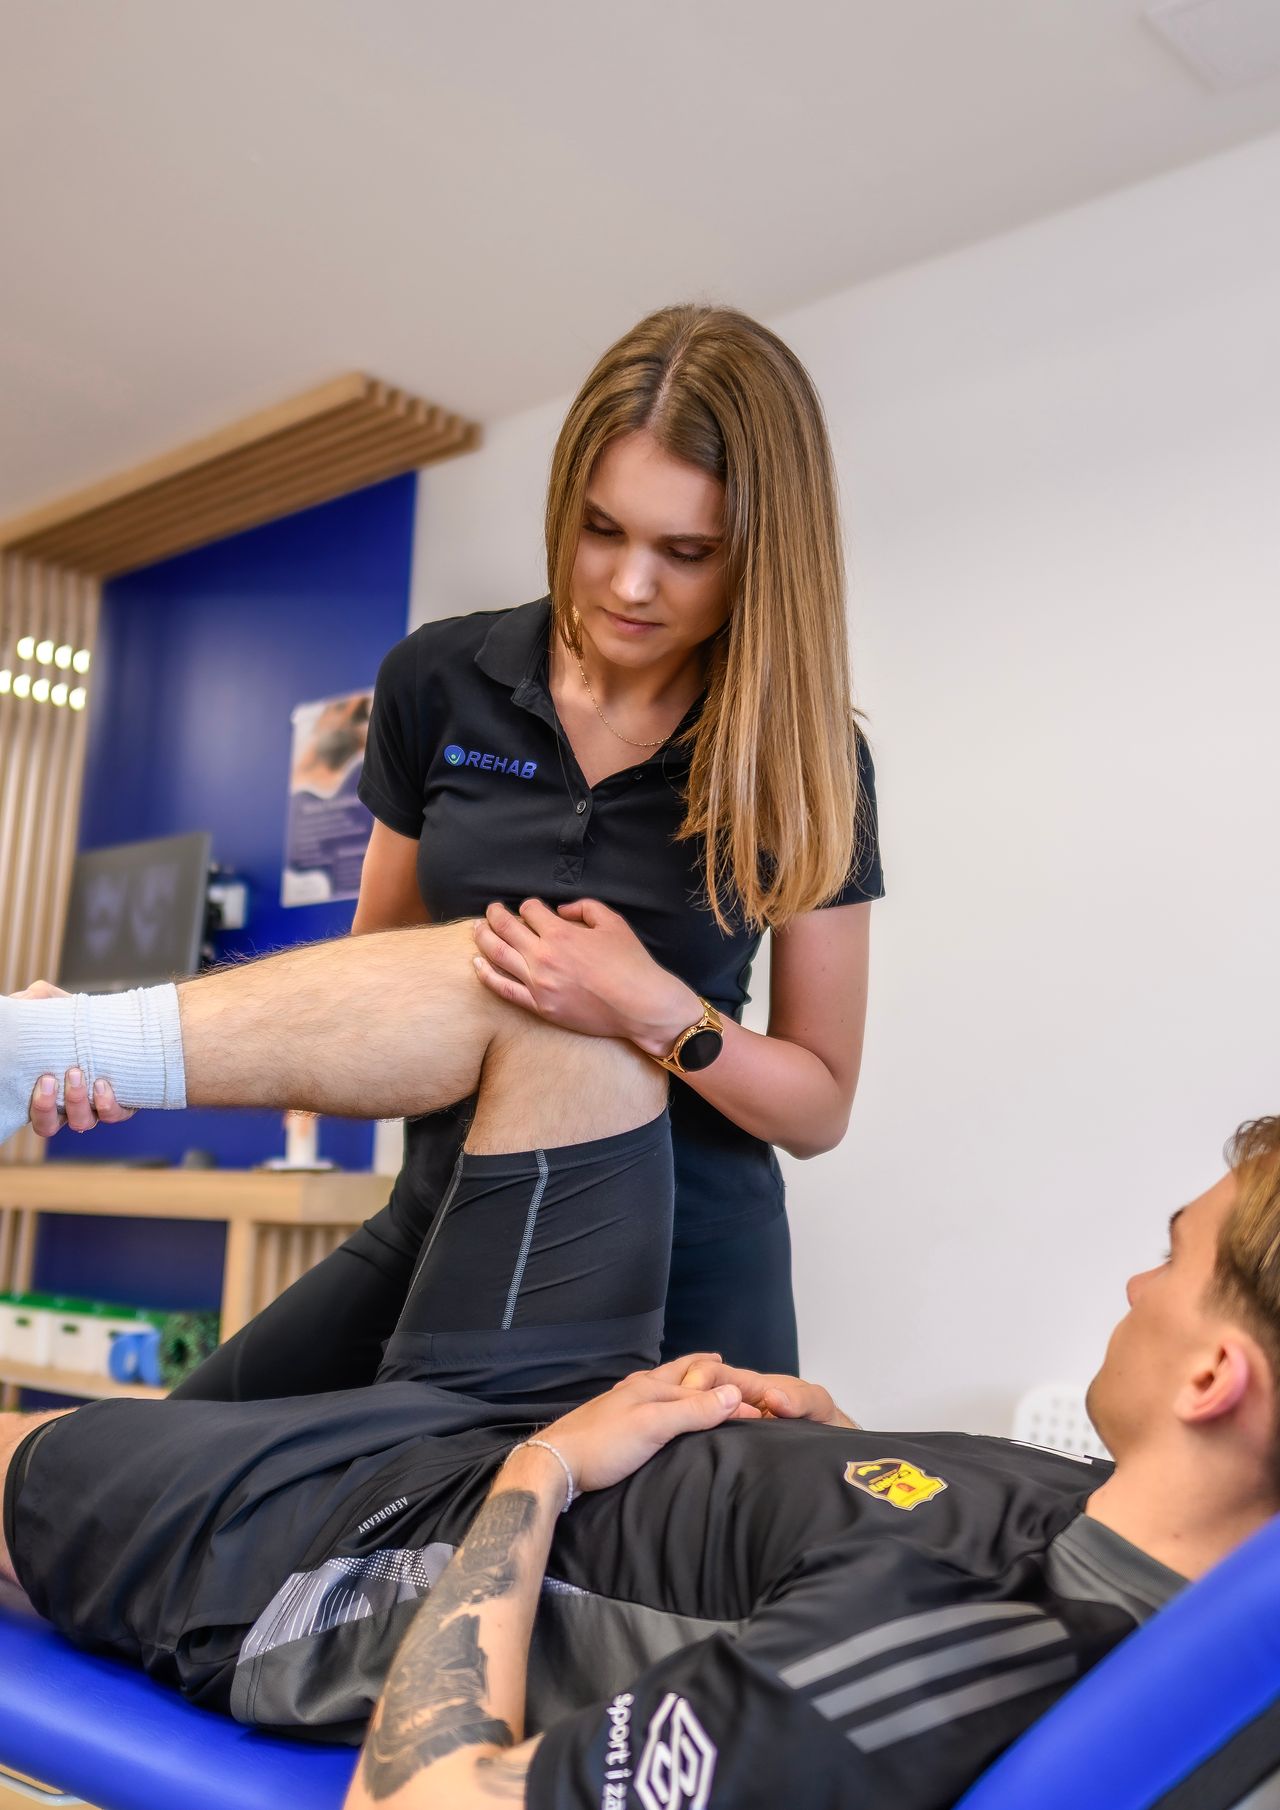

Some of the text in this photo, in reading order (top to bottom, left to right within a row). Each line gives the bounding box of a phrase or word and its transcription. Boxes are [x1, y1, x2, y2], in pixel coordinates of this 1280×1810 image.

[465, 750, 538, 780] REHAB
[357, 1496, 408, 1534] AEROREADY
[605, 1693, 635, 1766] sport
[604, 1768, 633, 1780] i
